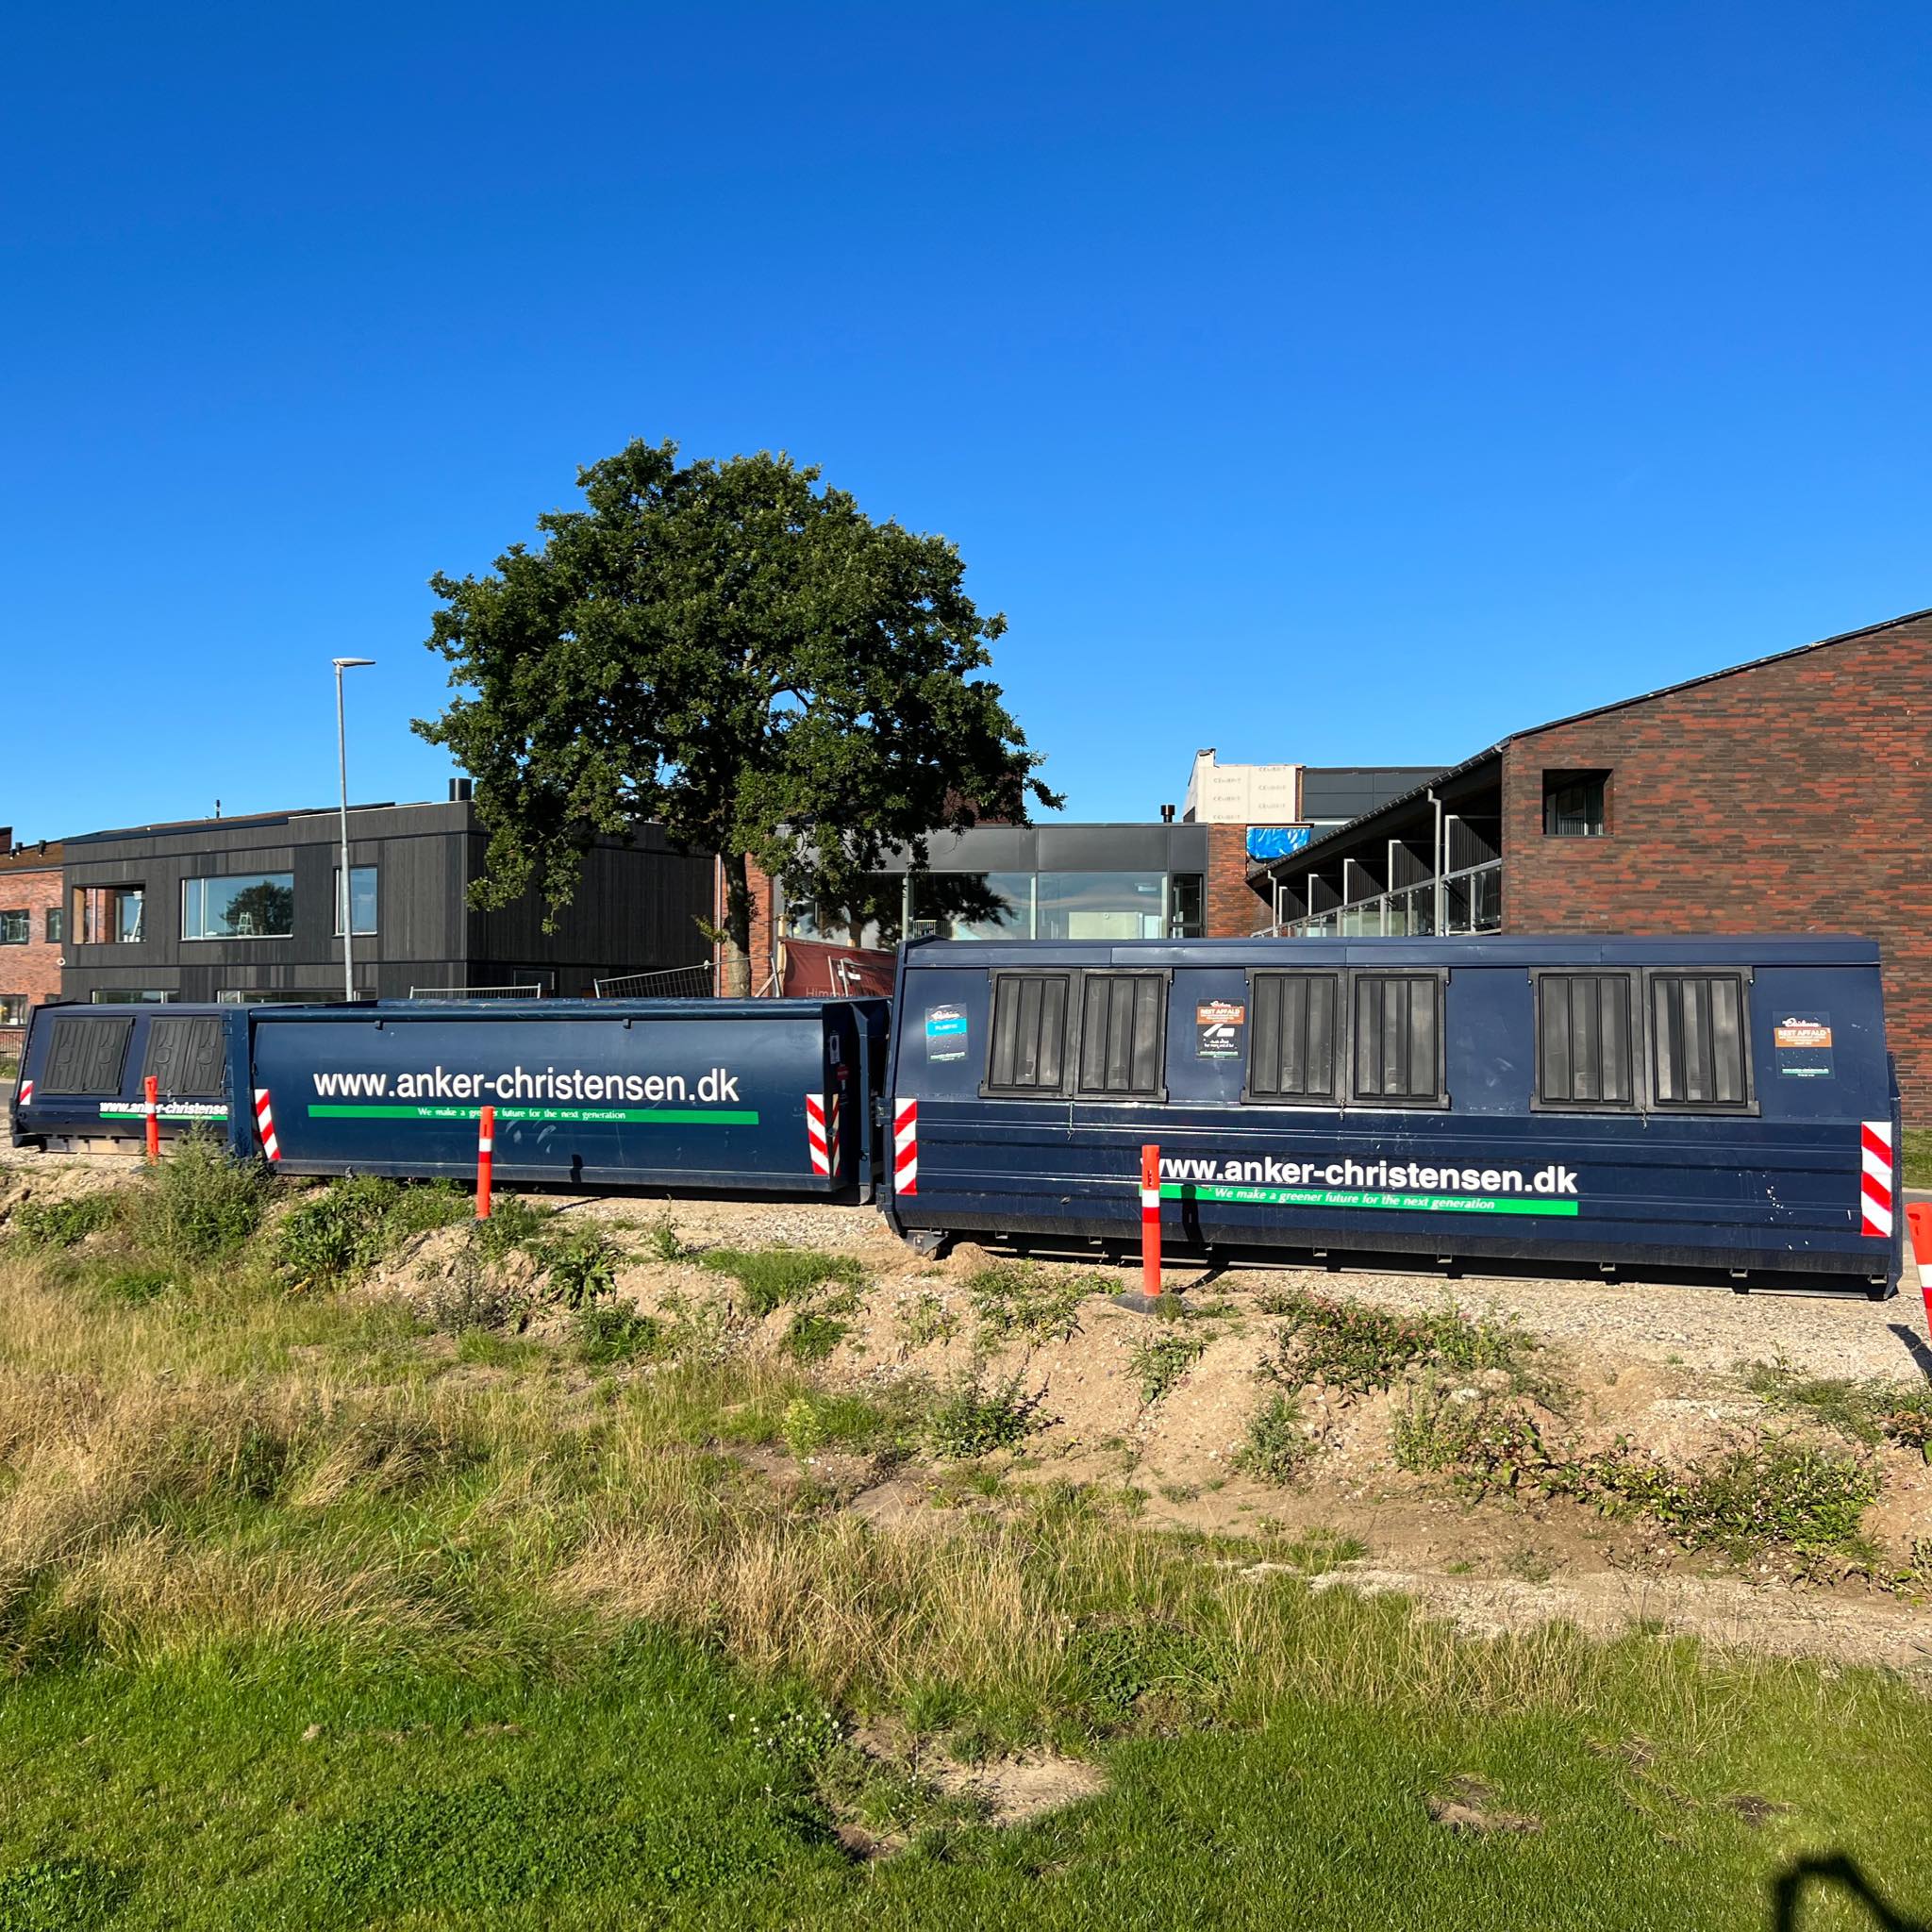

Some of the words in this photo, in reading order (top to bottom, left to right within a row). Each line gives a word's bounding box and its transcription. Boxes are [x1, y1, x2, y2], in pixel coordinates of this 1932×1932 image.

[312, 1065, 740, 1102] www.anker-christensen.dk
[417, 1107, 432, 1116] We
[435, 1108, 457, 1116] make
[502, 1108, 526, 1117] future
[529, 1108, 541, 1118] for
[544, 1109, 558, 1118] the
[582, 1110, 626, 1121] generation
[1214, 1188, 1233, 1198] We
[1237, 1189, 1266, 1199] make
[1279, 1192, 1322, 1203] greener
[1324, 1192, 1358, 1204] future
[1362, 1193, 1378, 1204] for
[1382, 1194, 1400, 1206] the
[1404, 1198, 1428, 1207] next
[1432, 1198, 1495, 1210] generation
